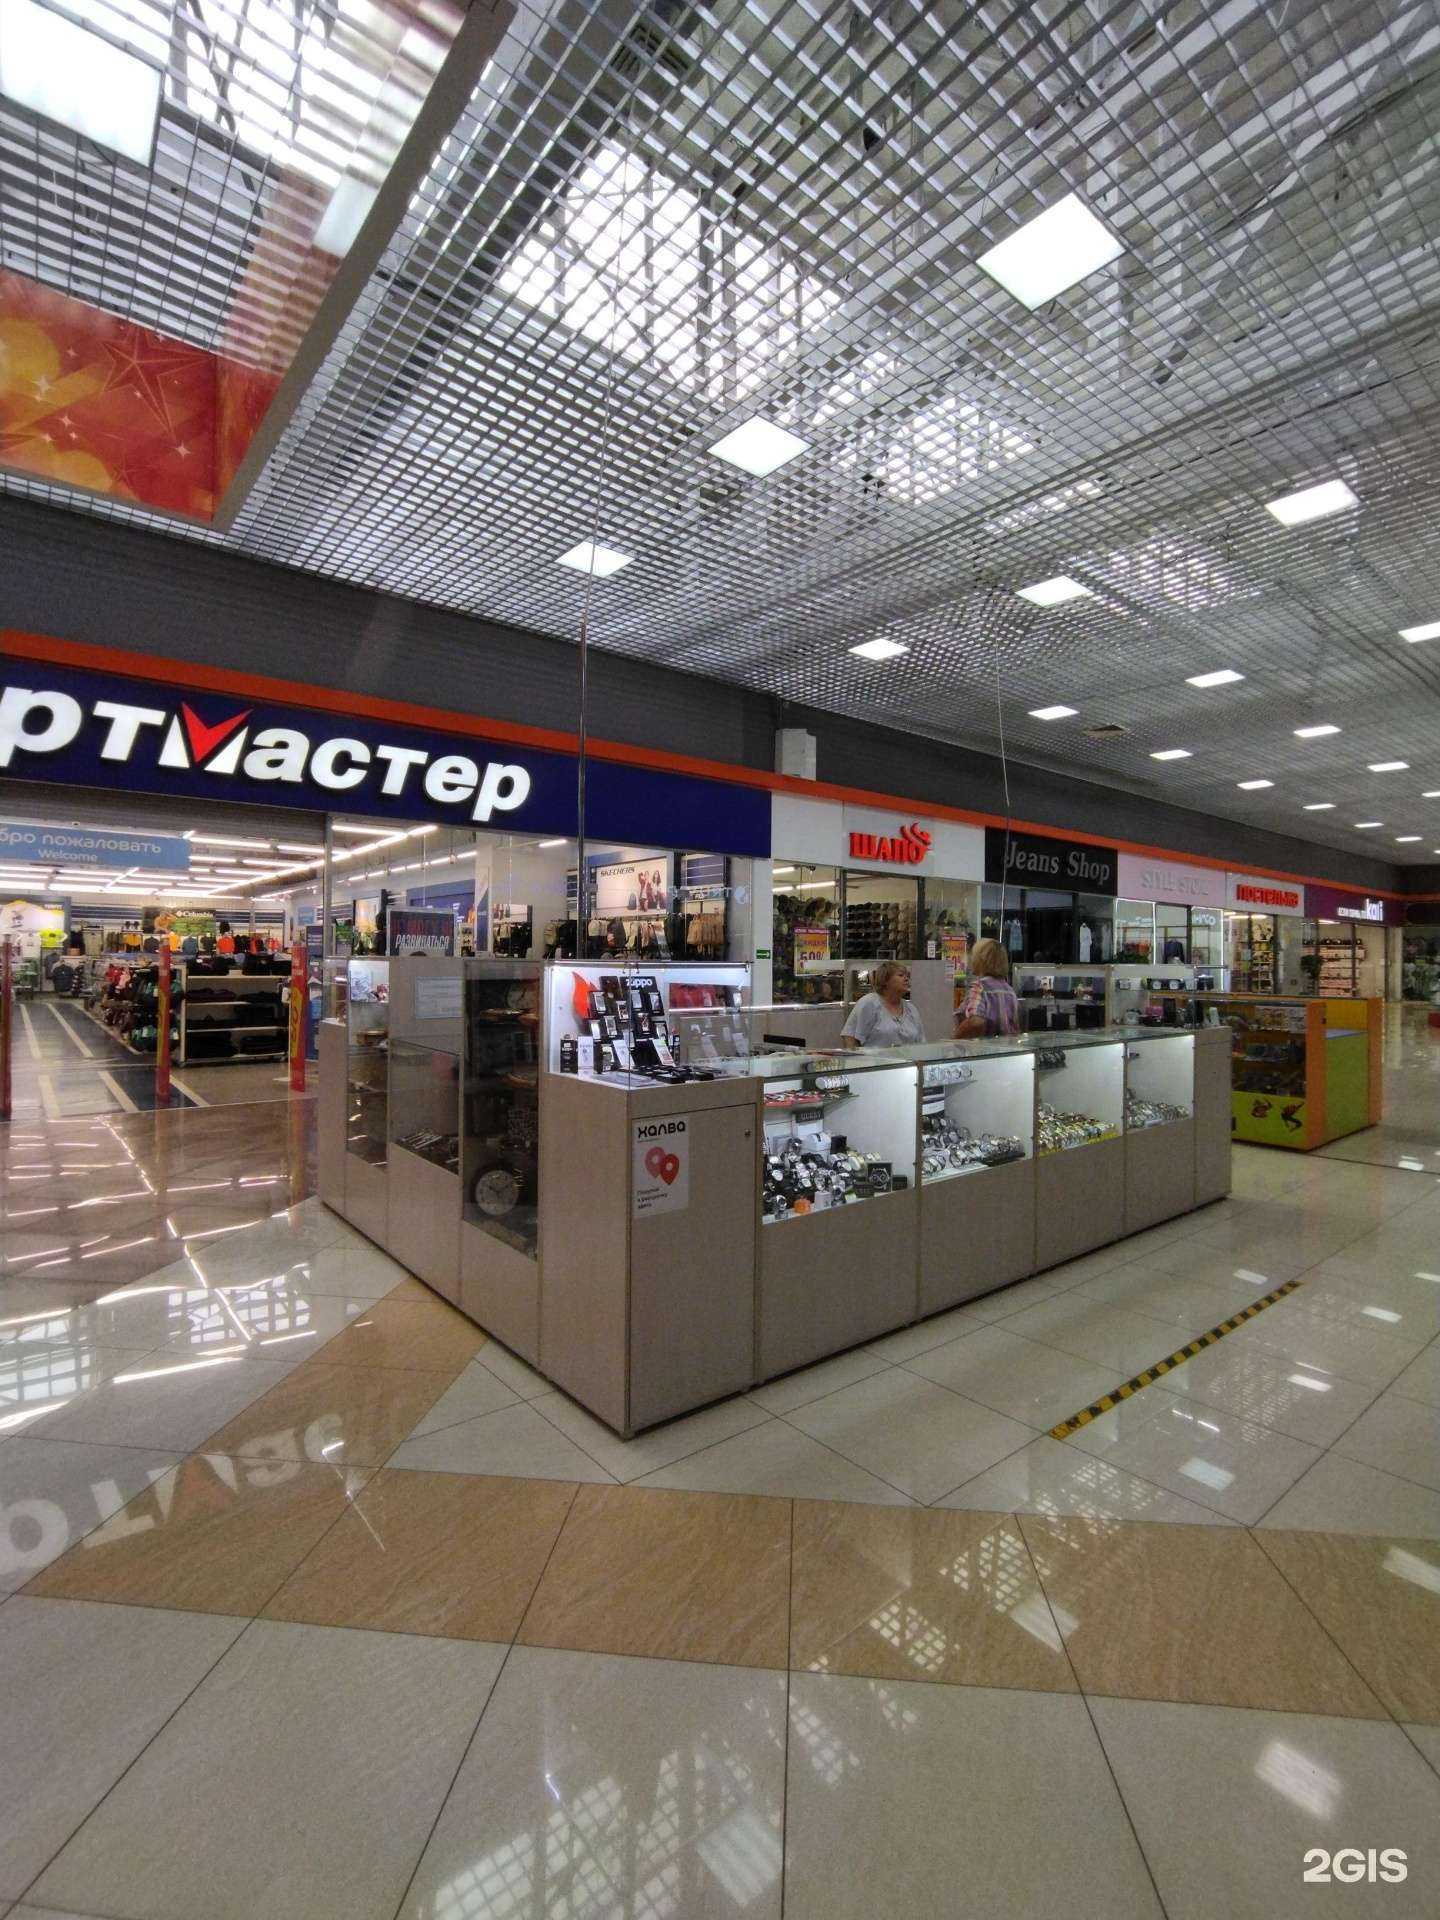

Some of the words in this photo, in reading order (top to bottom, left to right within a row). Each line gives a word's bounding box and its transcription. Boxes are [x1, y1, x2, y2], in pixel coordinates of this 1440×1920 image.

[42, 833, 162, 853] пожаловать
[38, 849, 98, 863] Welcome
[1005, 841, 1060, 874] Jeans
[1067, 851, 1110, 885] Shop
[183, 910, 214, 918] Columbia
